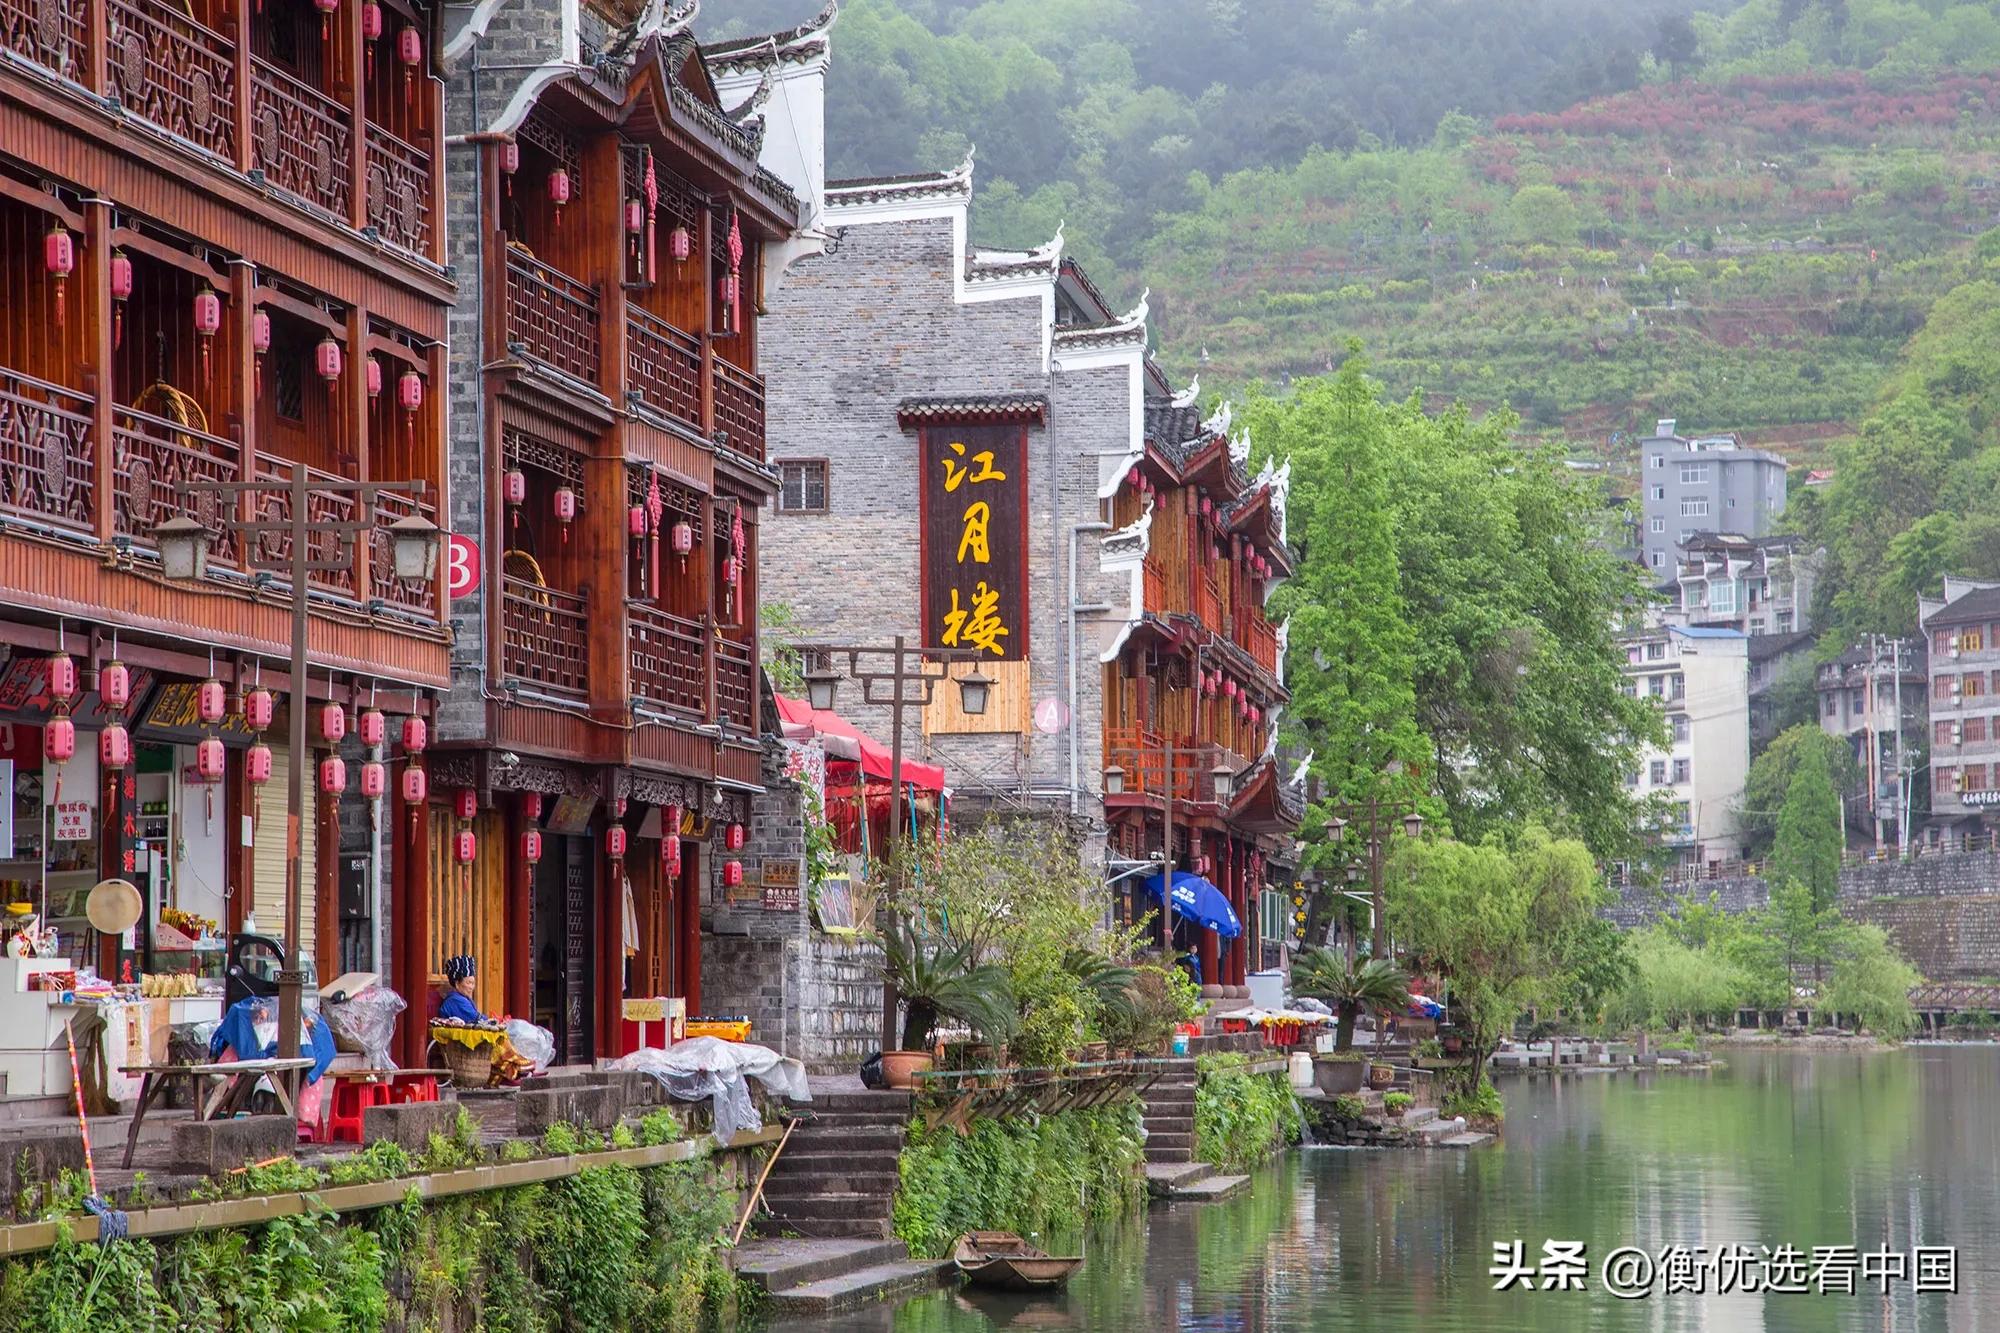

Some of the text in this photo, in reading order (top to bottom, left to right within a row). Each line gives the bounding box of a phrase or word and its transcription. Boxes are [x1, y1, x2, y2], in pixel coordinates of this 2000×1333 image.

[942, 442, 1009, 656] 江月楼
[450, 544, 471, 588] B
[1040, 701, 1064, 728] A
[58, 802, 88, 813] 糖尿病
[62, 815, 81, 825] 克星
